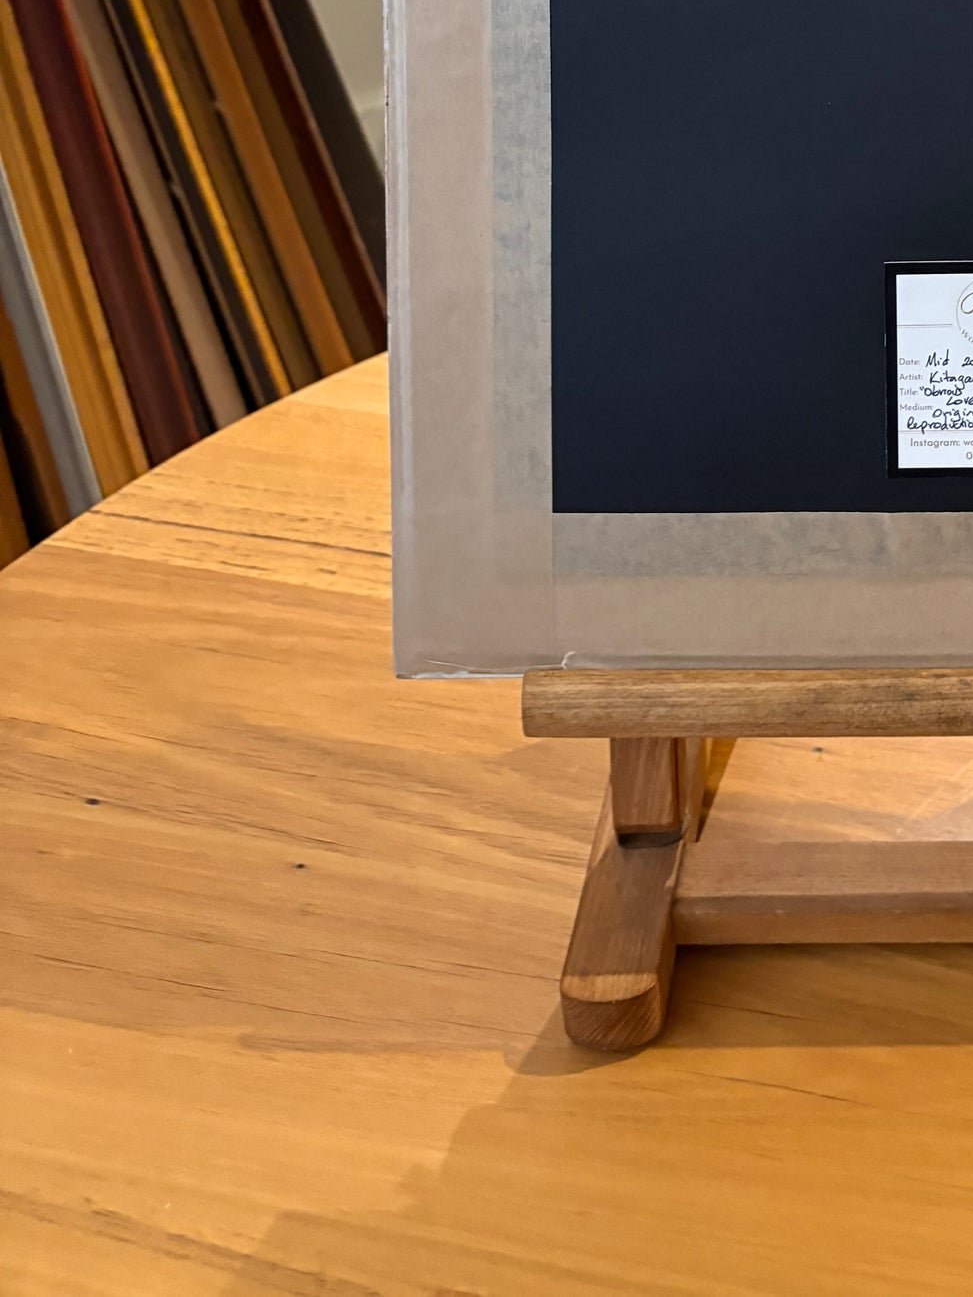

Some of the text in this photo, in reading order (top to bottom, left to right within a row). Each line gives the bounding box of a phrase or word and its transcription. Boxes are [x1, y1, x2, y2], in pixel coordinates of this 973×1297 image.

[925, 349, 949, 367] Mid
[899, 388, 919, 396] Title:
[910, 438, 960, 447] Instagram:
